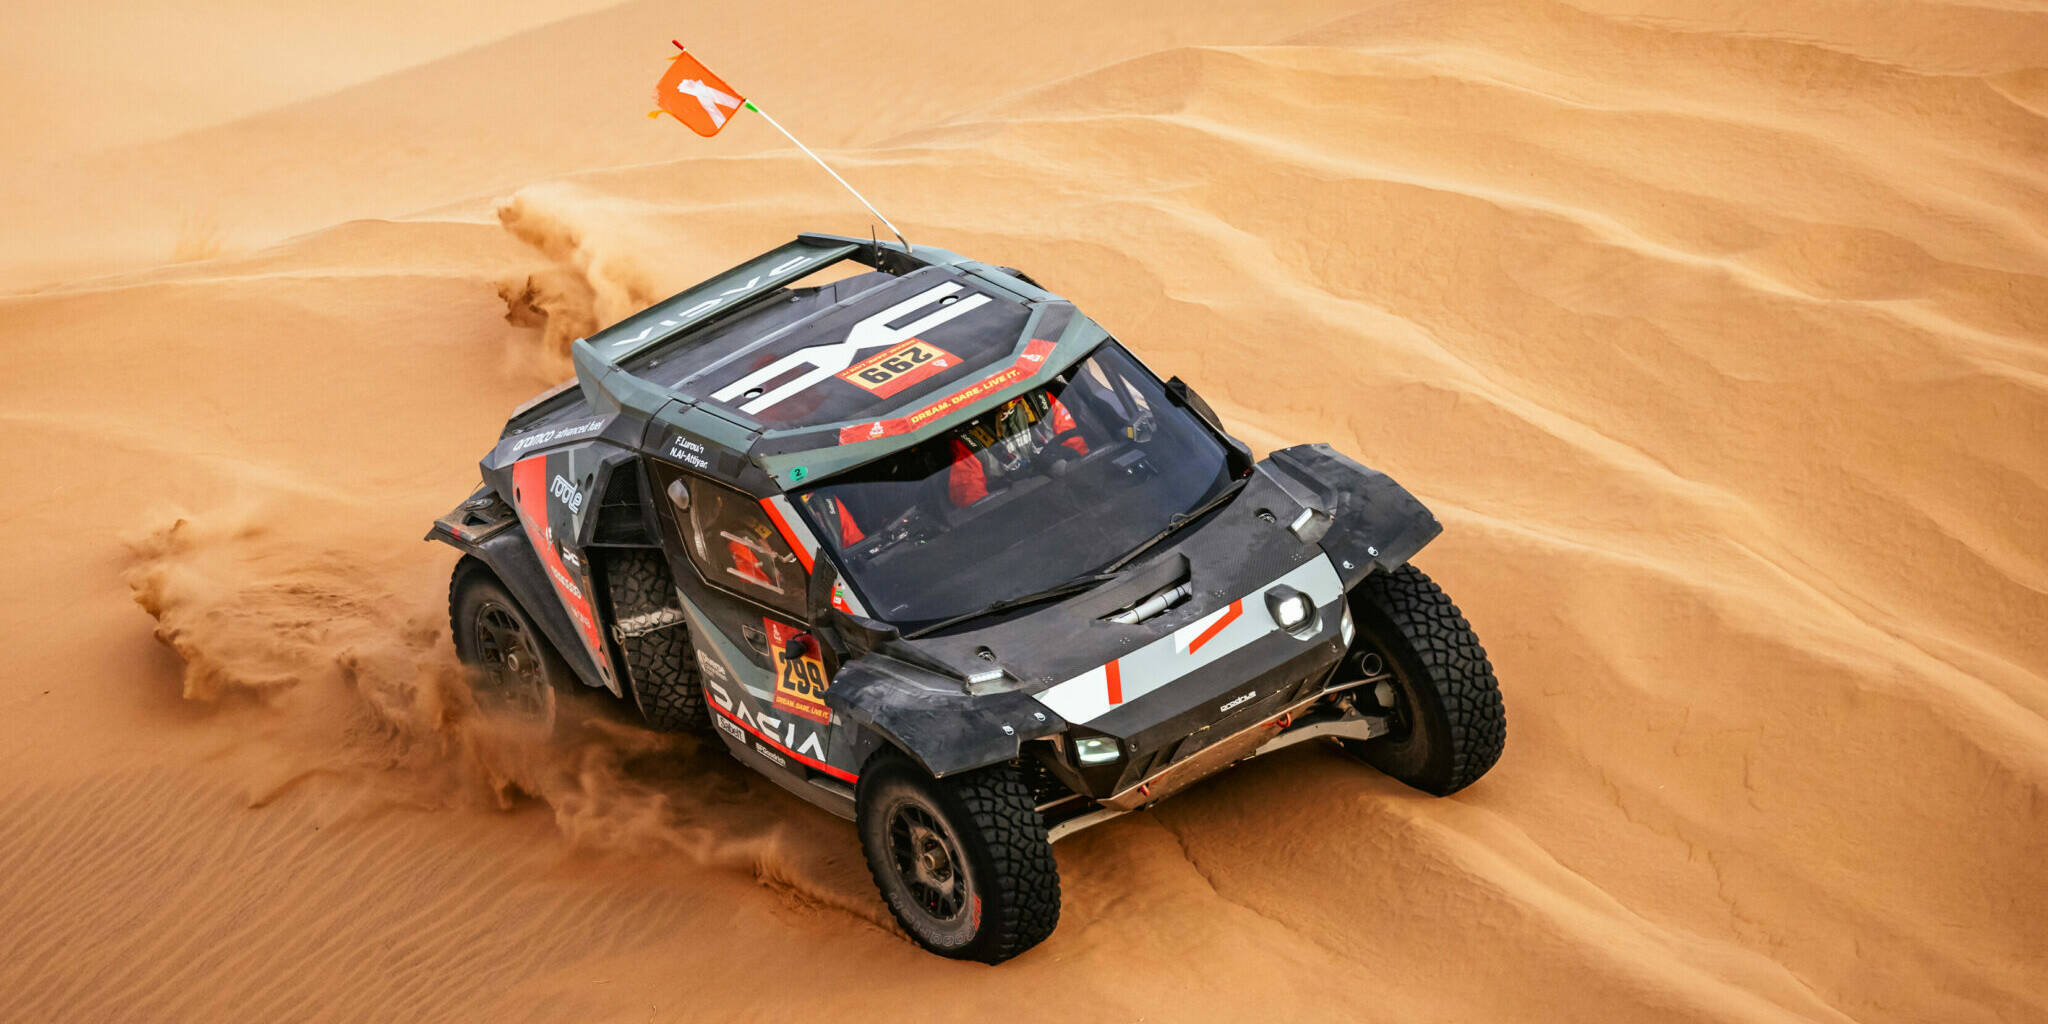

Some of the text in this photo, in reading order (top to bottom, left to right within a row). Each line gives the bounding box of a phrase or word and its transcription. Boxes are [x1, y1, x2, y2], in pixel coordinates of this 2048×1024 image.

[858, 346, 934, 384] 299
[911, 402, 952, 424] DREAM.
[952, 387, 983, 405] DARE.
[983, 375, 1006, 390] LIVE
[1005, 369, 1021, 381] IT.
[794, 467, 803, 477] 2
[779, 651, 826, 700] 299
[710, 680, 827, 762] DACIA
